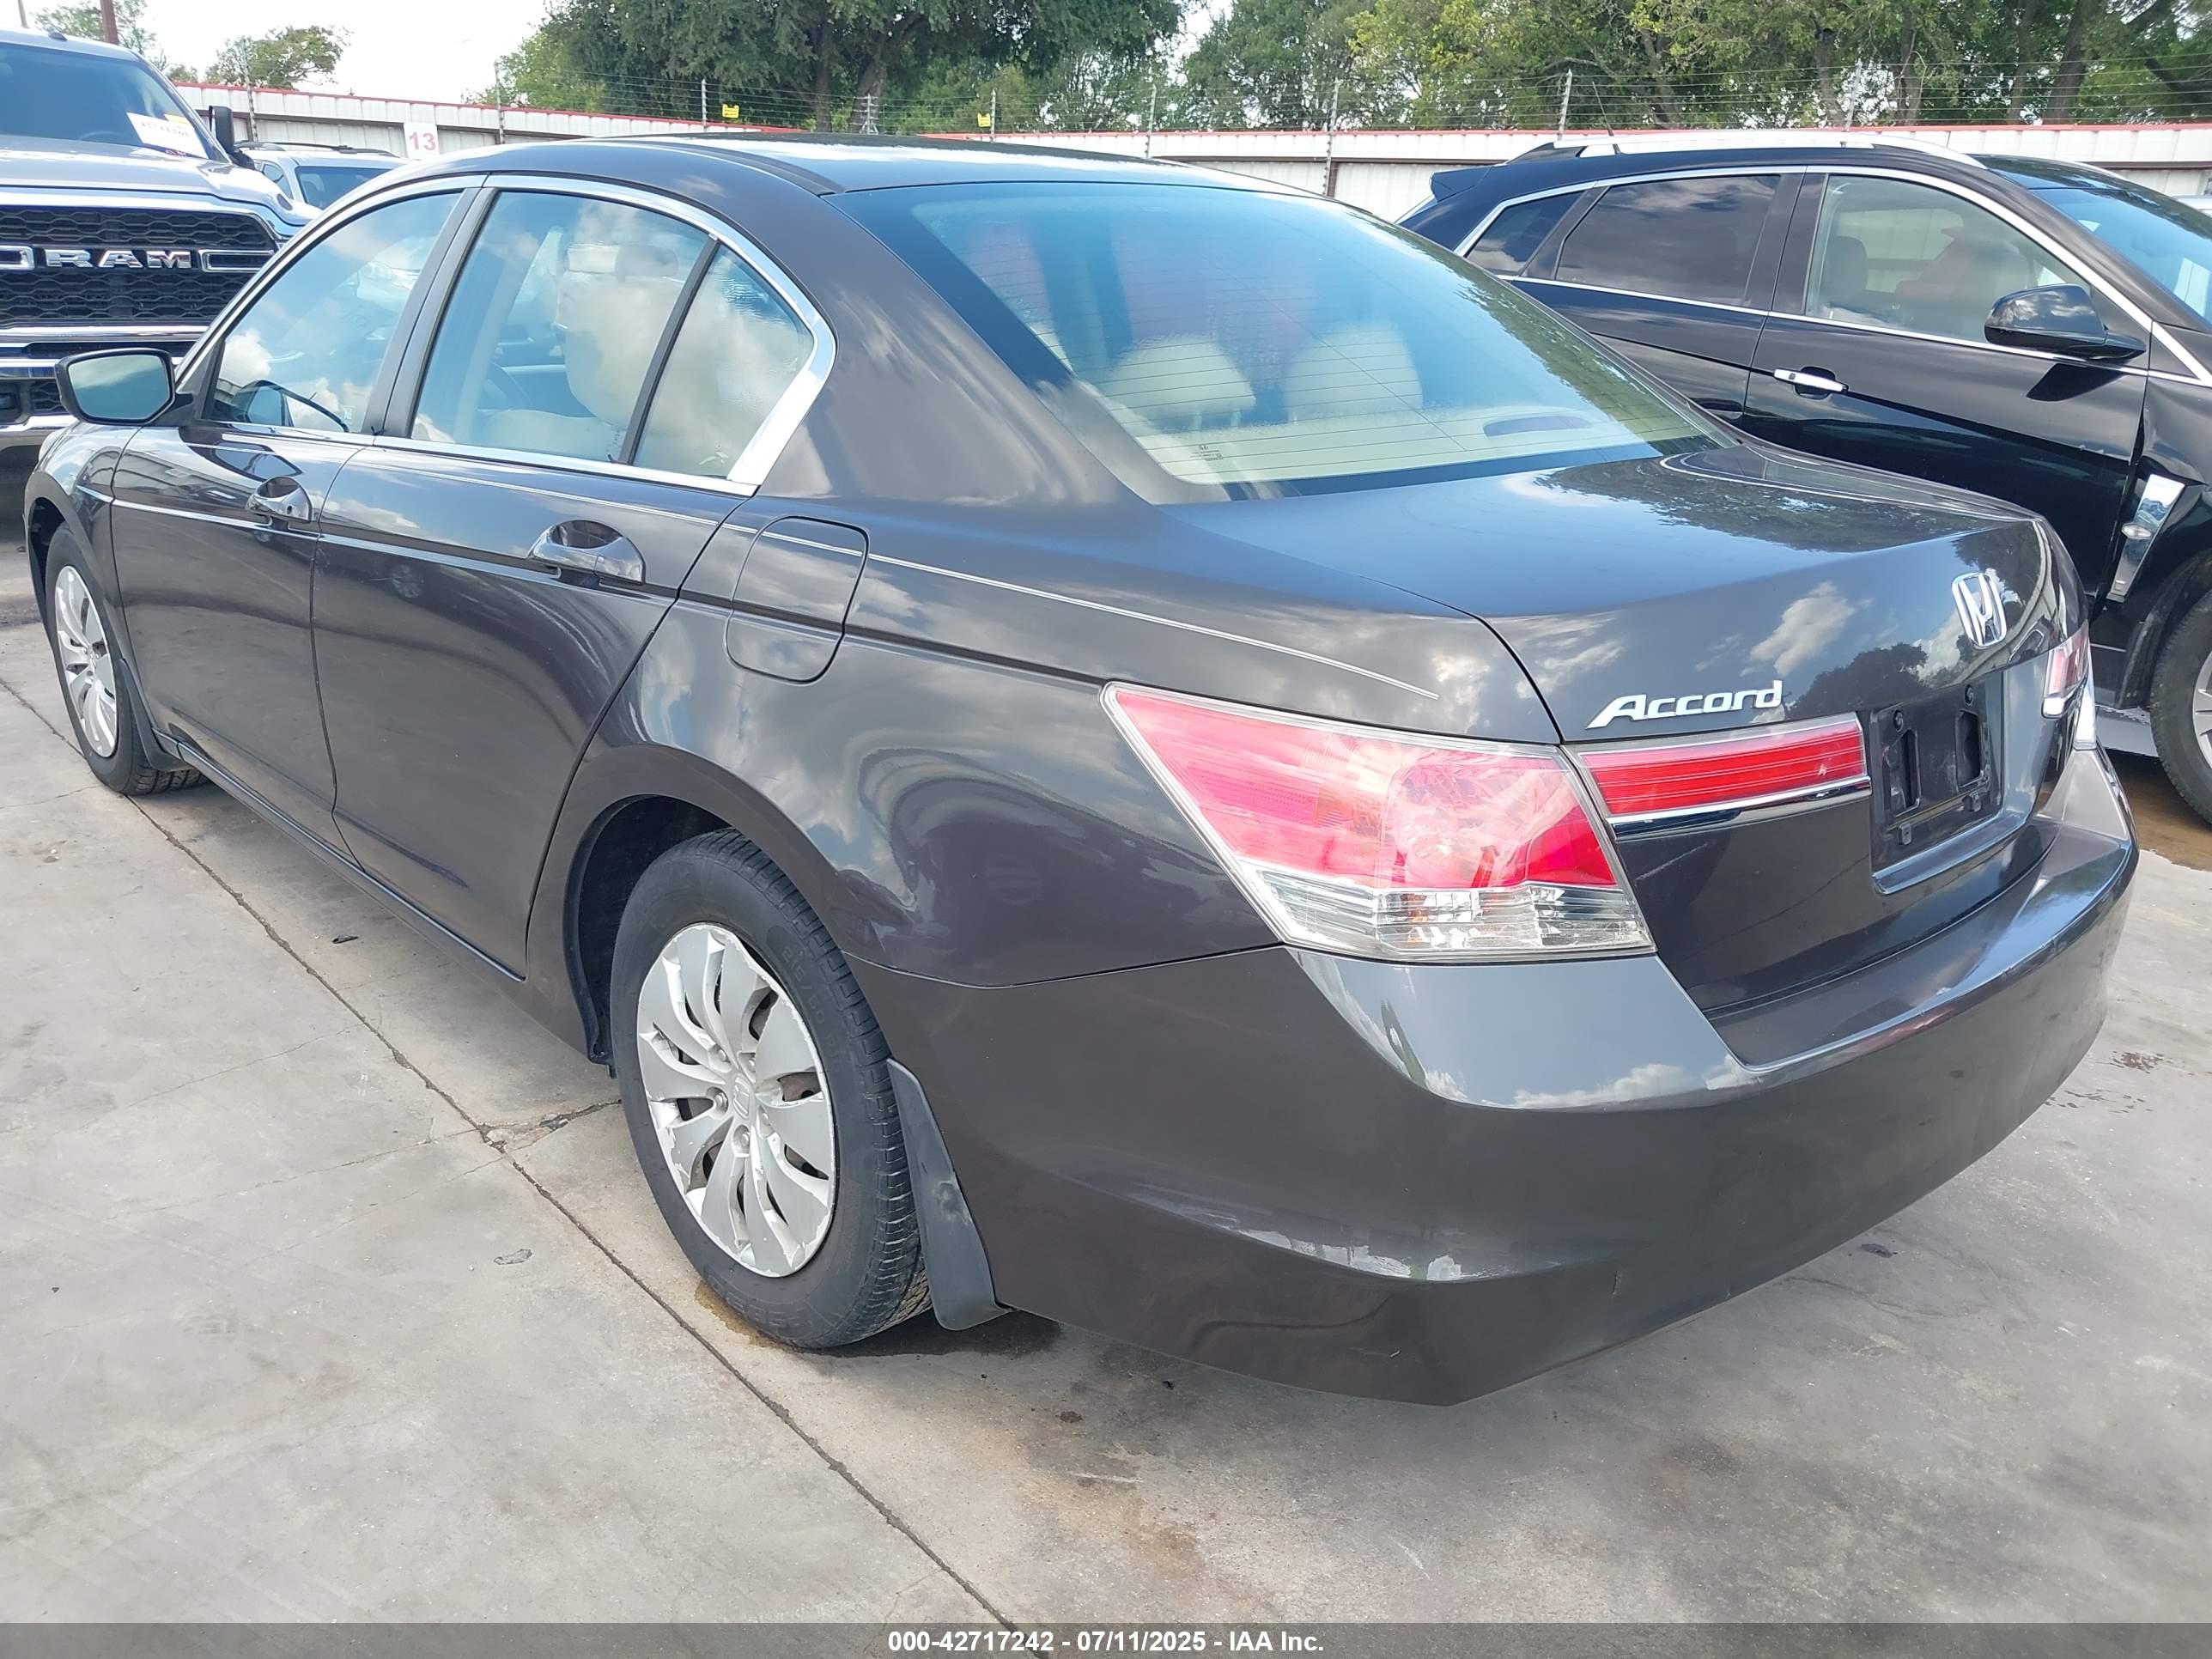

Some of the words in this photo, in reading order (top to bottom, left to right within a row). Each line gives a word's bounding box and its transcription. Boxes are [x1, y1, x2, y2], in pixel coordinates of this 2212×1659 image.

[408, 131, 436, 151] 13
[45, 249, 192, 269] RAM
[1586, 679, 1784, 730] Accord
